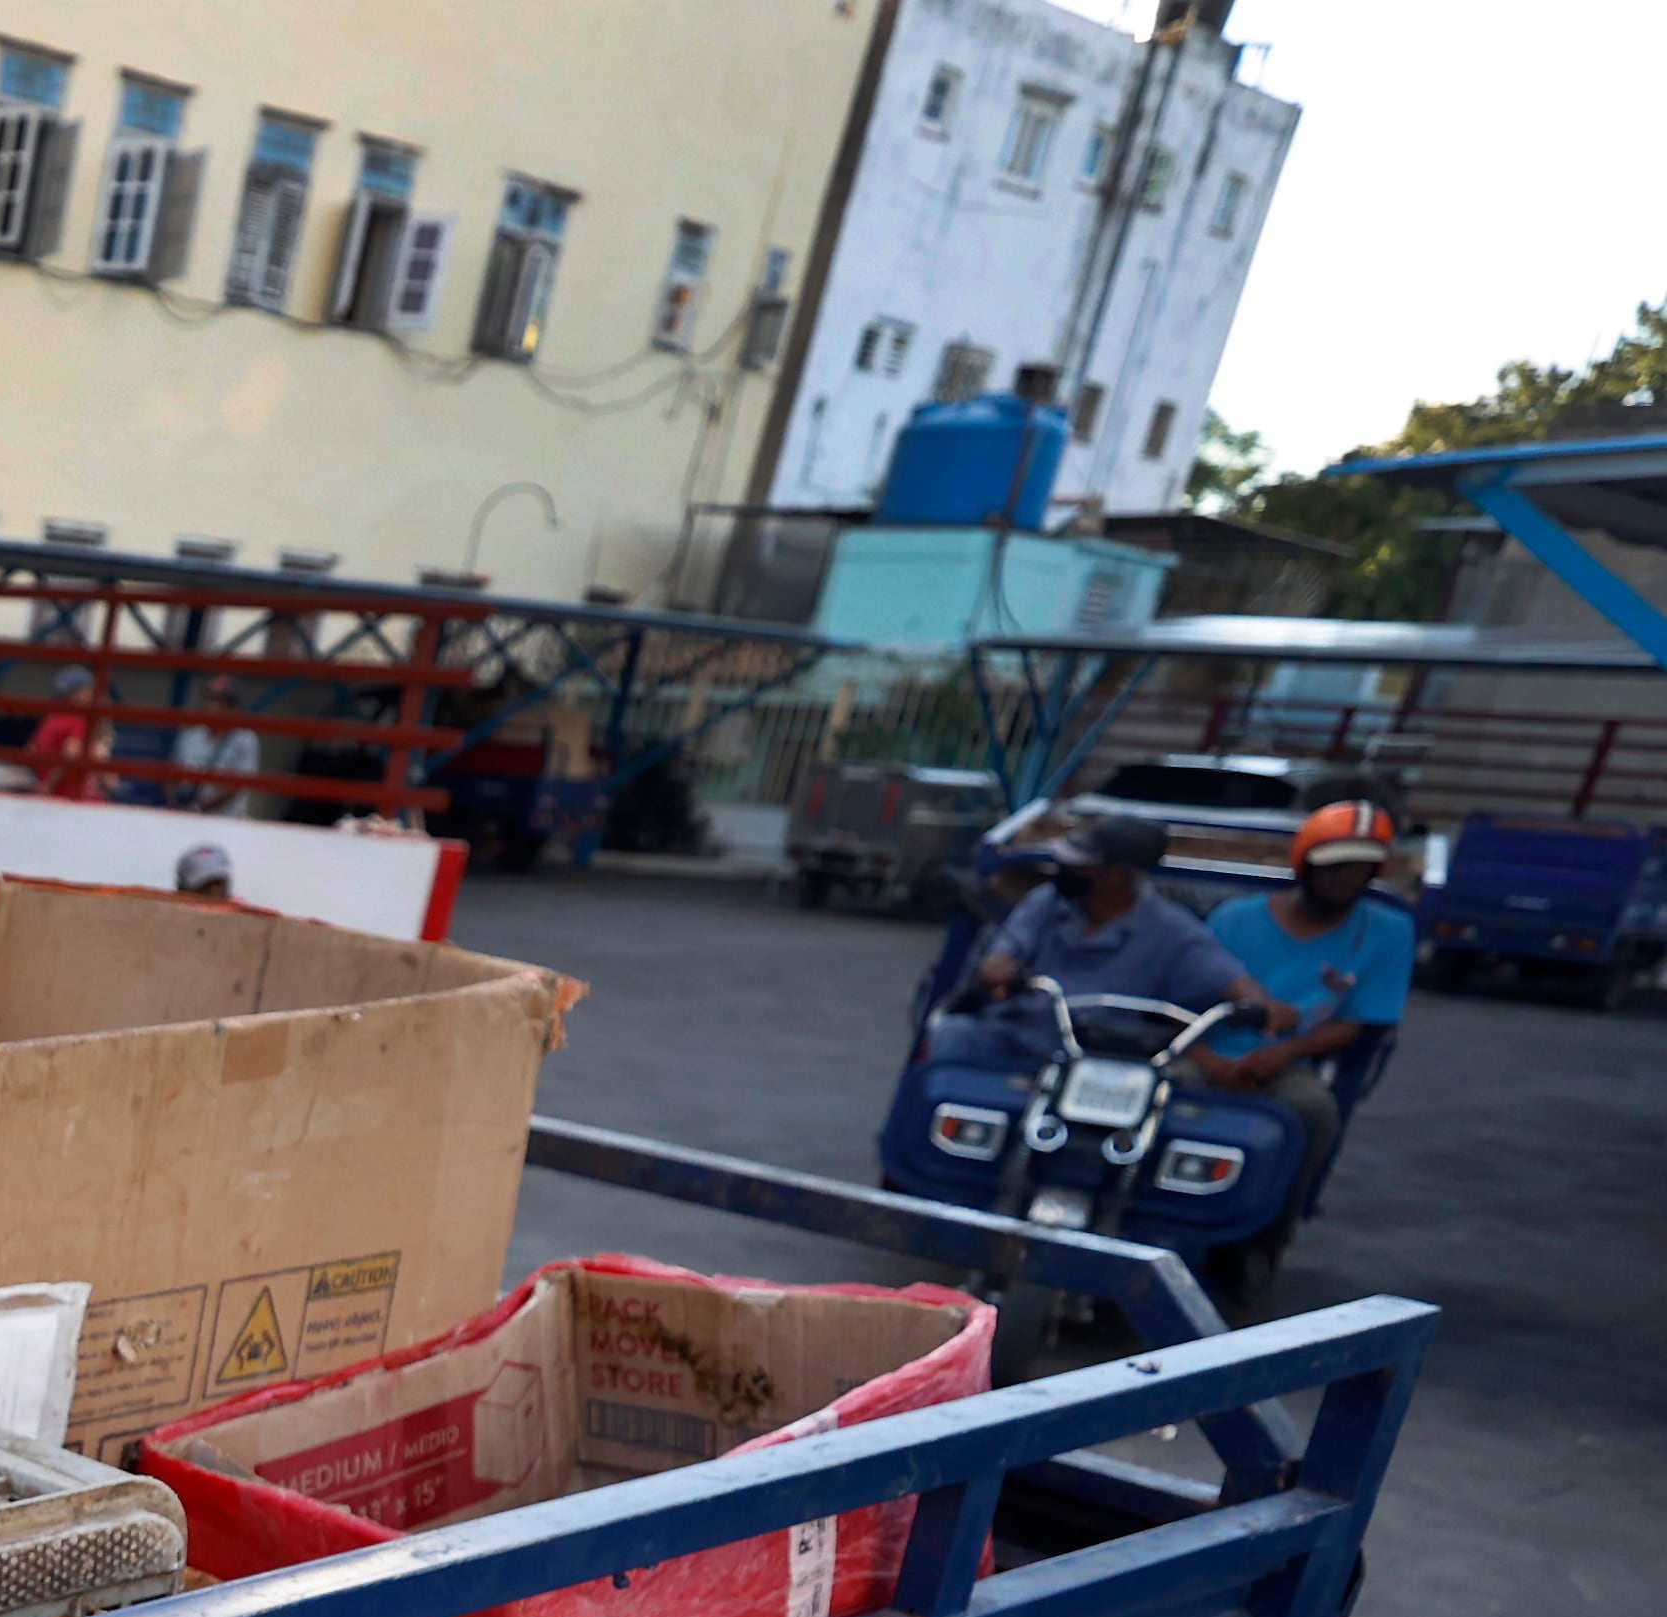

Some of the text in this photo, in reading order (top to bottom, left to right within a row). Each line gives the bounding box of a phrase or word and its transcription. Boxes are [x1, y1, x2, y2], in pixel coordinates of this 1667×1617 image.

[330, 1266, 393, 1290] CAUTION
[588, 1292, 663, 1327] PACK
[590, 1361, 684, 1400] STORE
[404, 1425, 460, 1460] MEDIO
